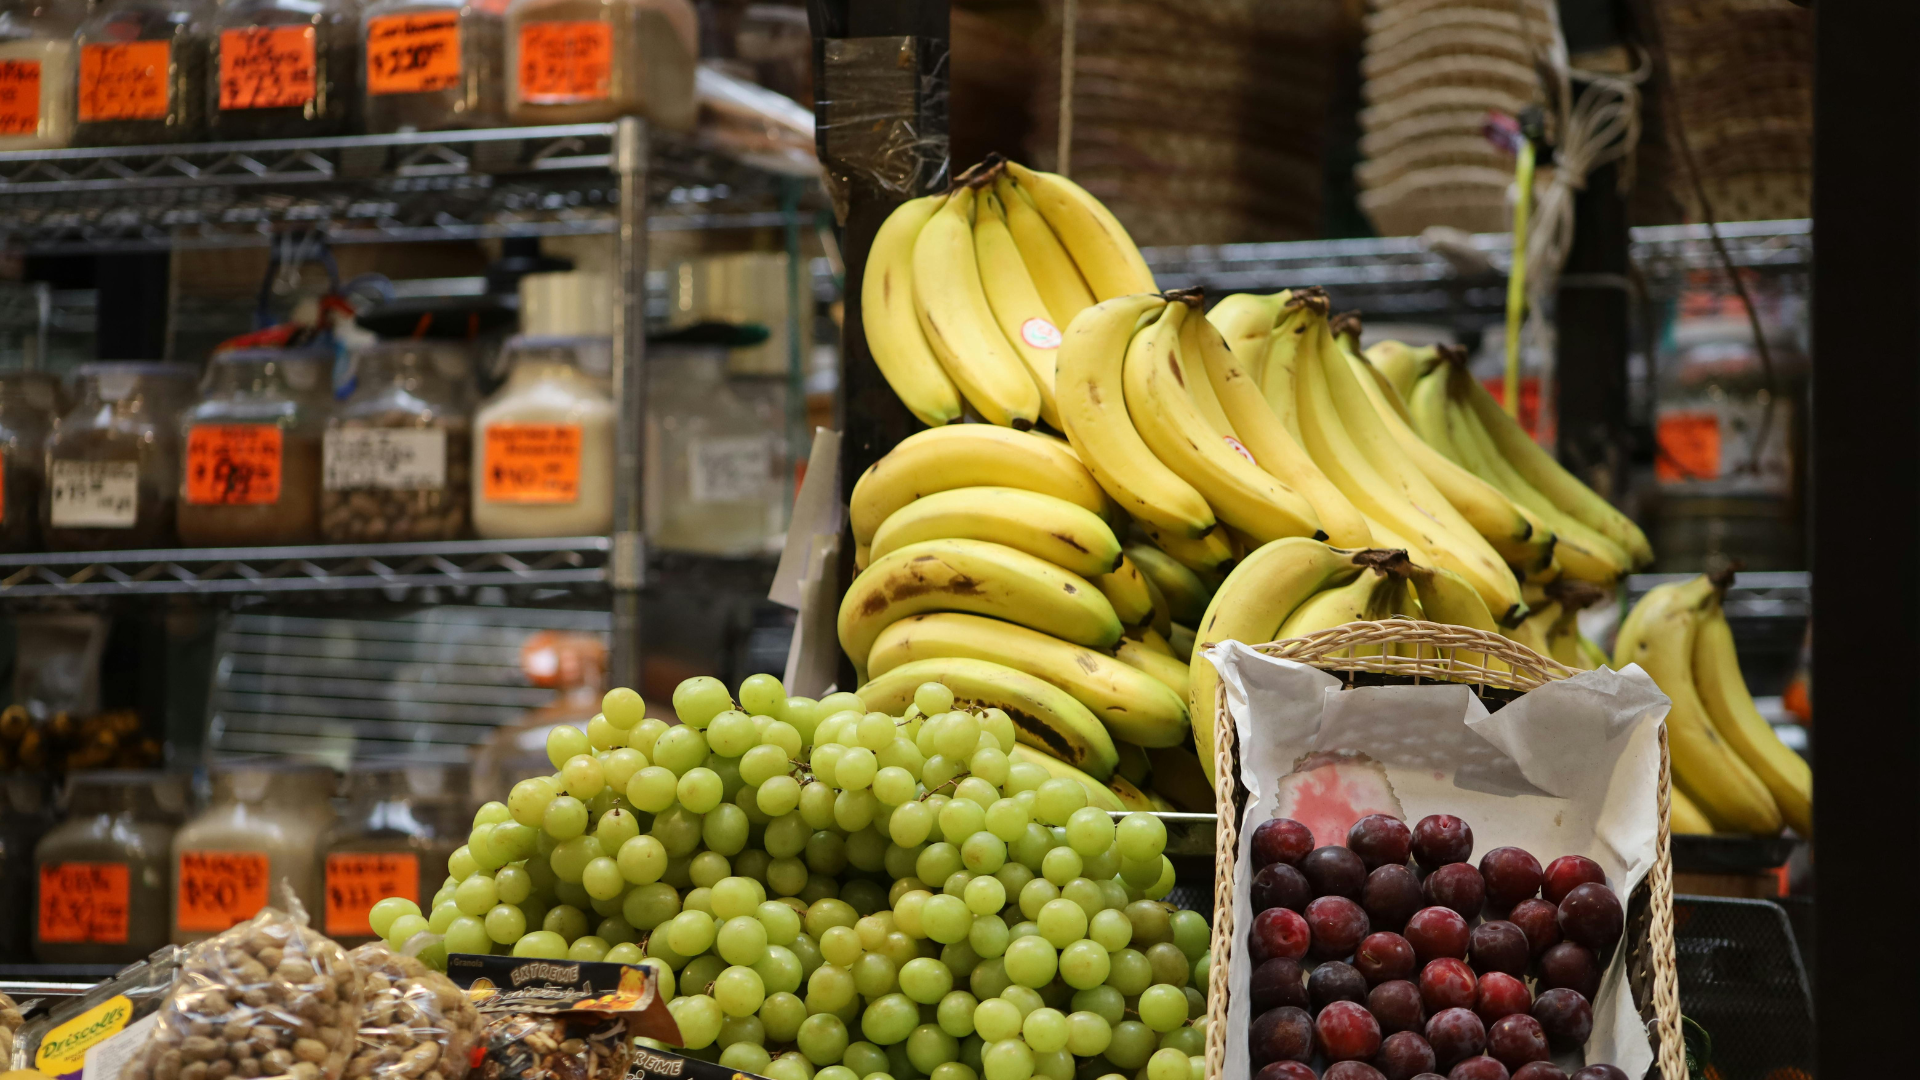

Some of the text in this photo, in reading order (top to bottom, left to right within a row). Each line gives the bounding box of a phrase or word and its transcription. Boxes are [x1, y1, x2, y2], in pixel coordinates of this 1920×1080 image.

[453, 957, 484, 968] Granola
[511, 962, 581, 987] EXTREME
[42, 1006, 124, 1059] Driscoll's
[633, 1051, 683, 1076] REME
